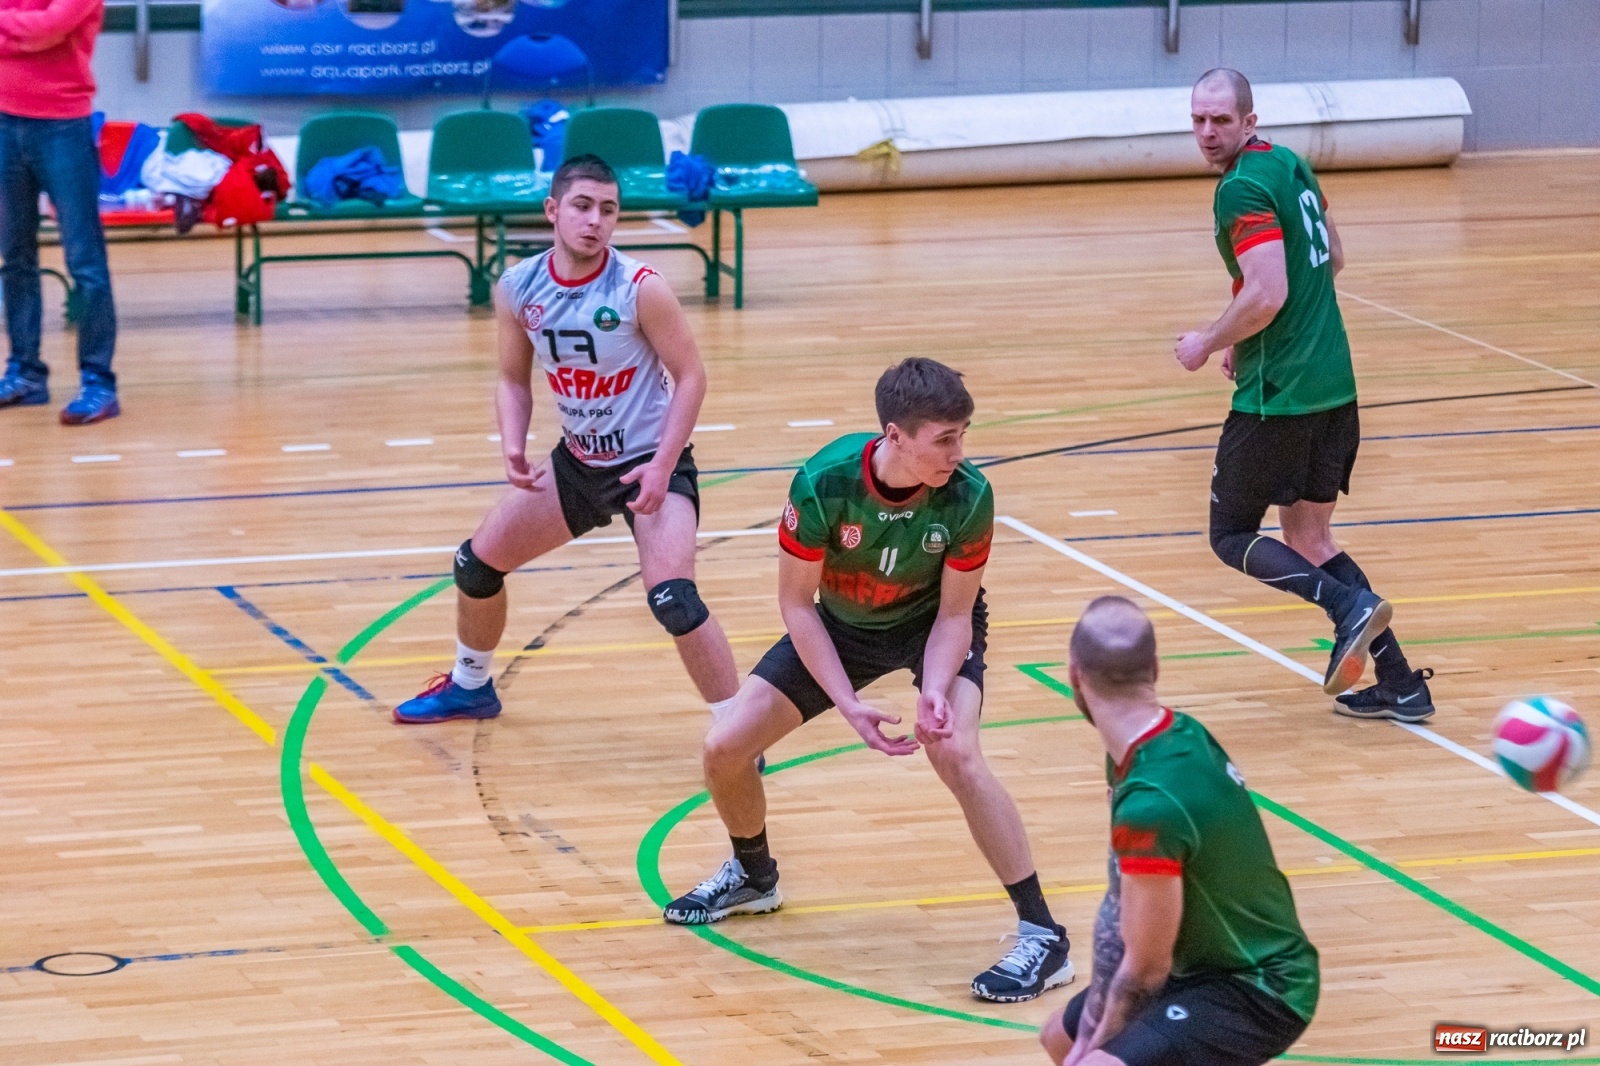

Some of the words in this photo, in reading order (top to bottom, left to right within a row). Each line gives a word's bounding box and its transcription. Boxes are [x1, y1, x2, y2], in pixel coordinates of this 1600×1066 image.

[542, 329, 597, 364] 17
[589, 406, 613, 418] PBG
[878, 547, 898, 576] 11
